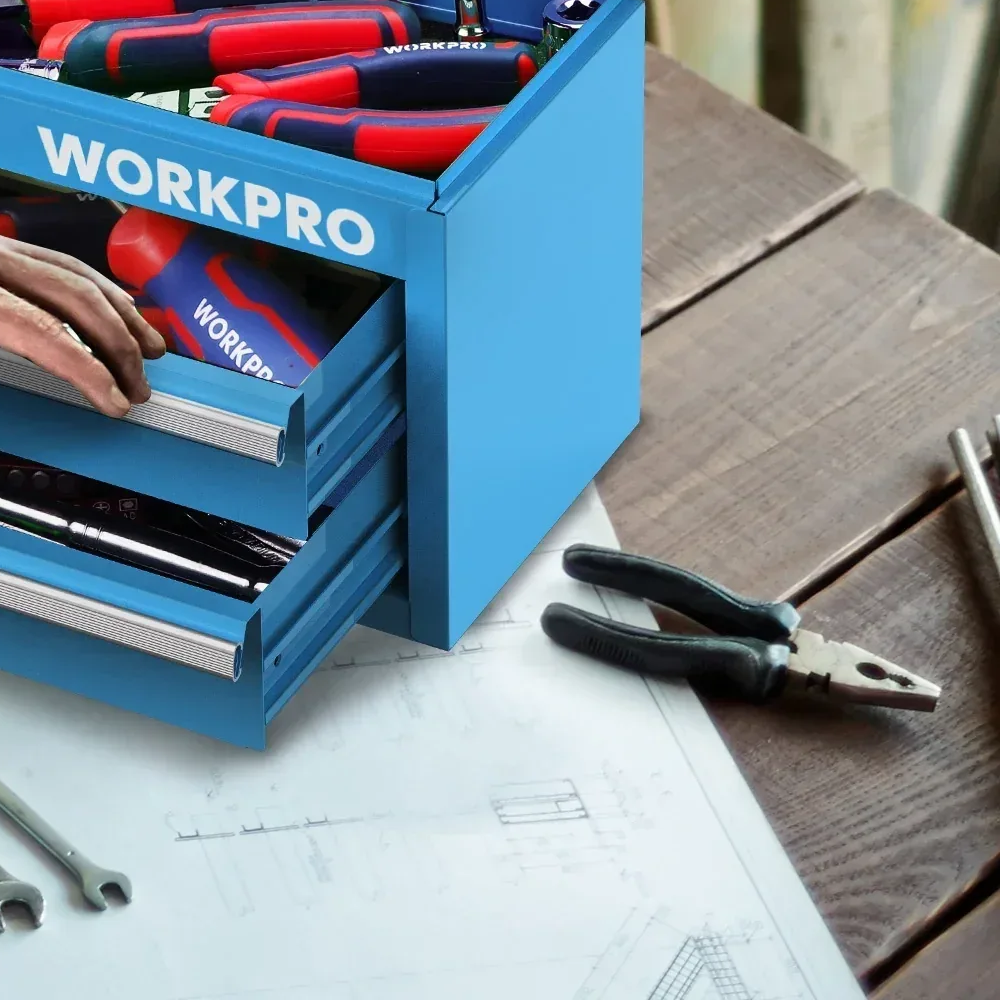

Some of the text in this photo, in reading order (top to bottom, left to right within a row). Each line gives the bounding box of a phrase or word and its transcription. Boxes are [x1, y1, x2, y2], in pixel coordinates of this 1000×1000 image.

[383, 41, 487, 55] WORKPRO
[37, 125, 376, 256] WORKPRO
[193, 297, 284, 385] WORKPR
